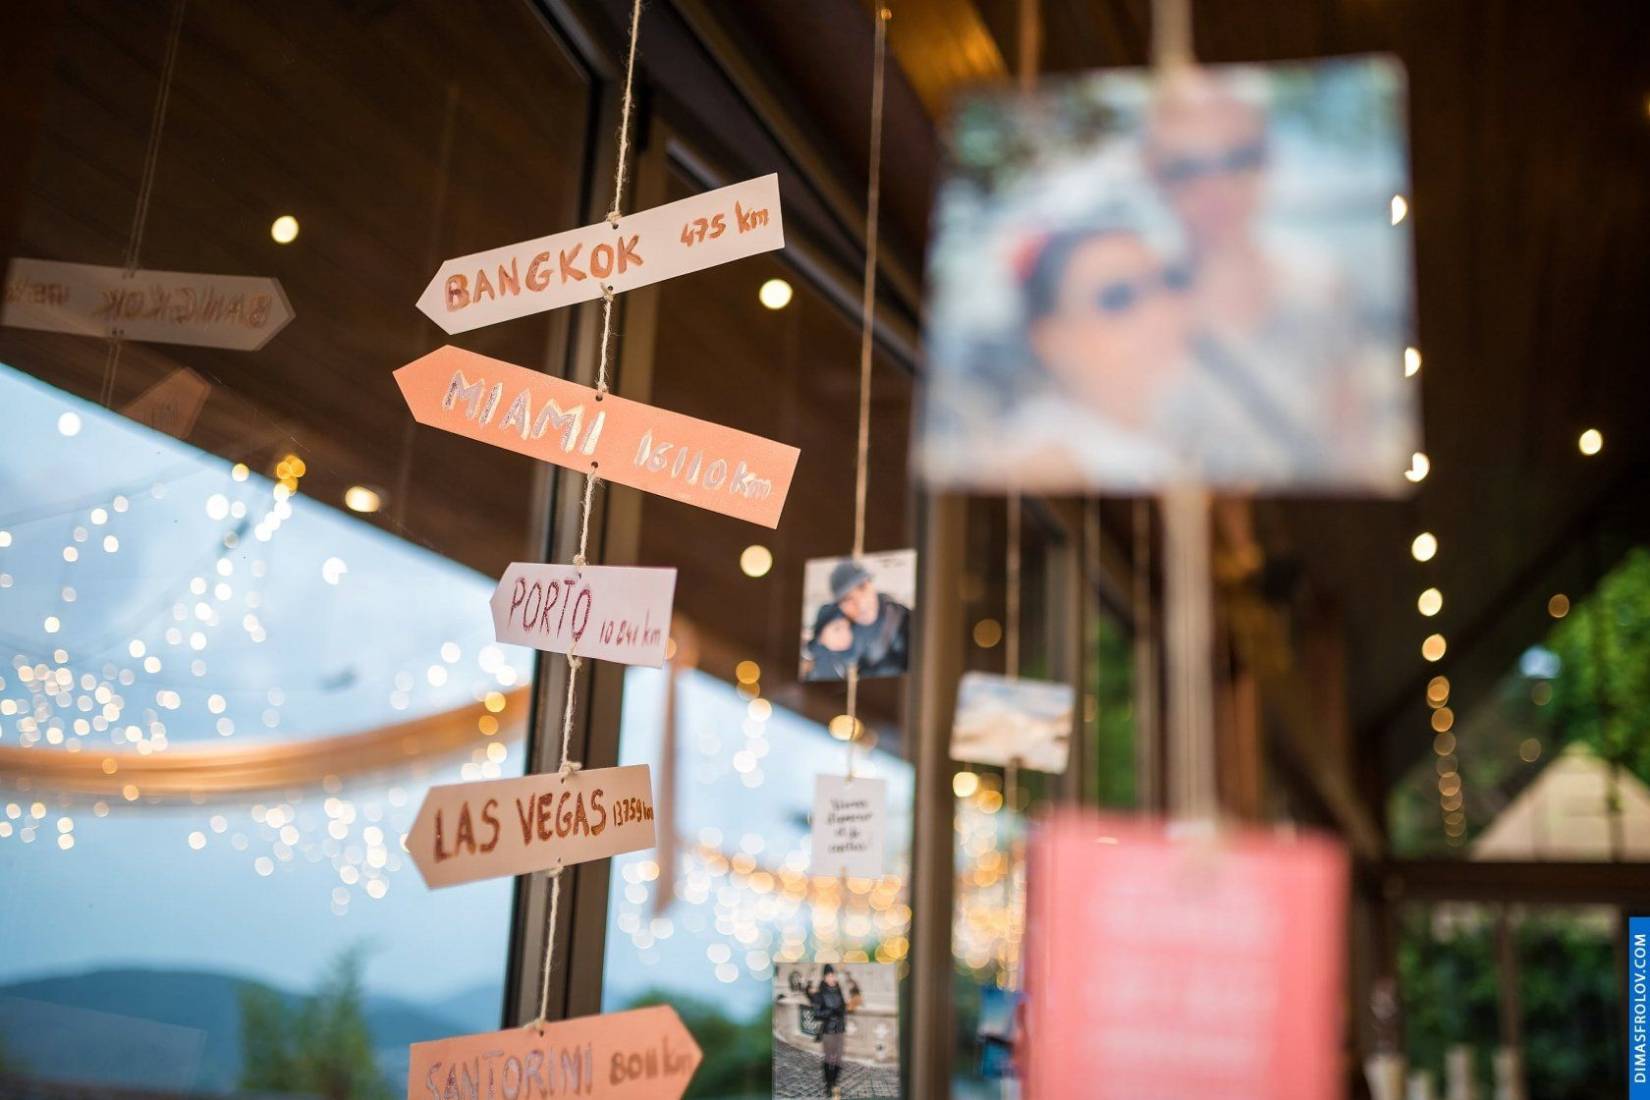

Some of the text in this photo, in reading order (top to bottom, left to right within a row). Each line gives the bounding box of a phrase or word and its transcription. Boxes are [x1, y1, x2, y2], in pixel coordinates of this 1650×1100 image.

[444, 201, 770, 312] BANGKOK 475 km
[441, 370, 606, 455] MIAMI
[508, 577, 593, 641] PORTO
[434, 799, 500, 862] LAS
[516, 789, 607, 845] VEGAS
[426, 1044, 594, 1100] SANTORINI
